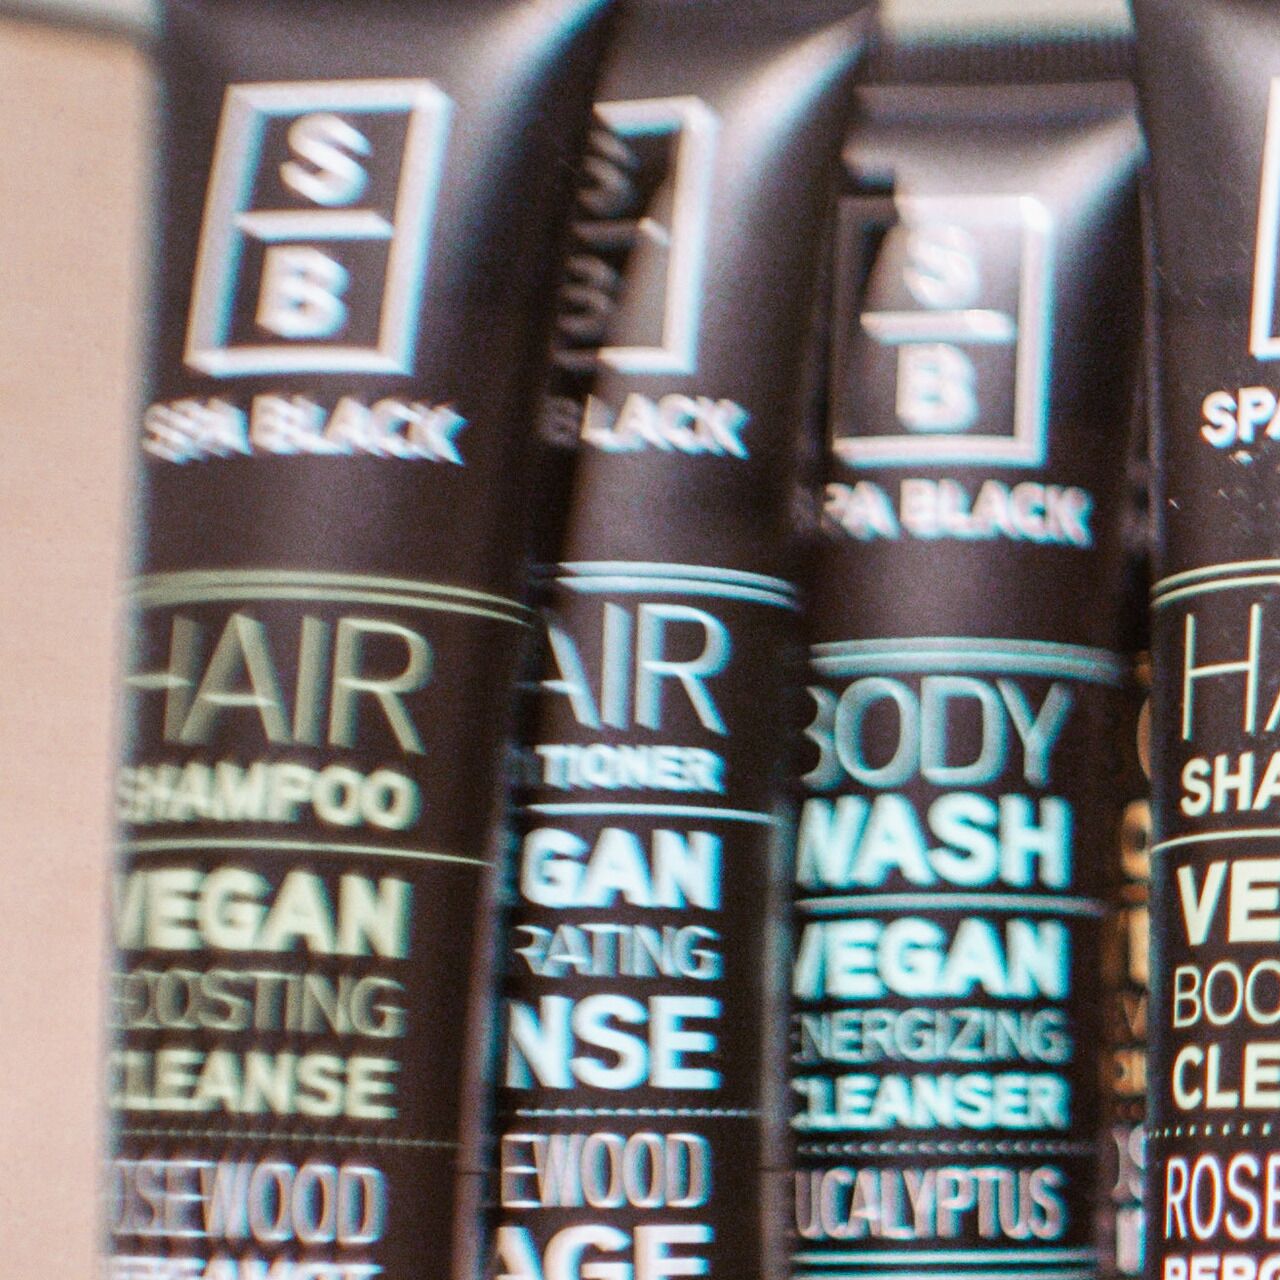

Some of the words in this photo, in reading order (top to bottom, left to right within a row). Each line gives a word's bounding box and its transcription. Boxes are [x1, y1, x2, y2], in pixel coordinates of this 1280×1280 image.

[279, 113, 373, 207] S
[255, 246, 351, 339] B
[251, 394, 469, 466] BLACK
[895, 341, 980, 434] B
[899, 477, 1096, 549] BLACK
